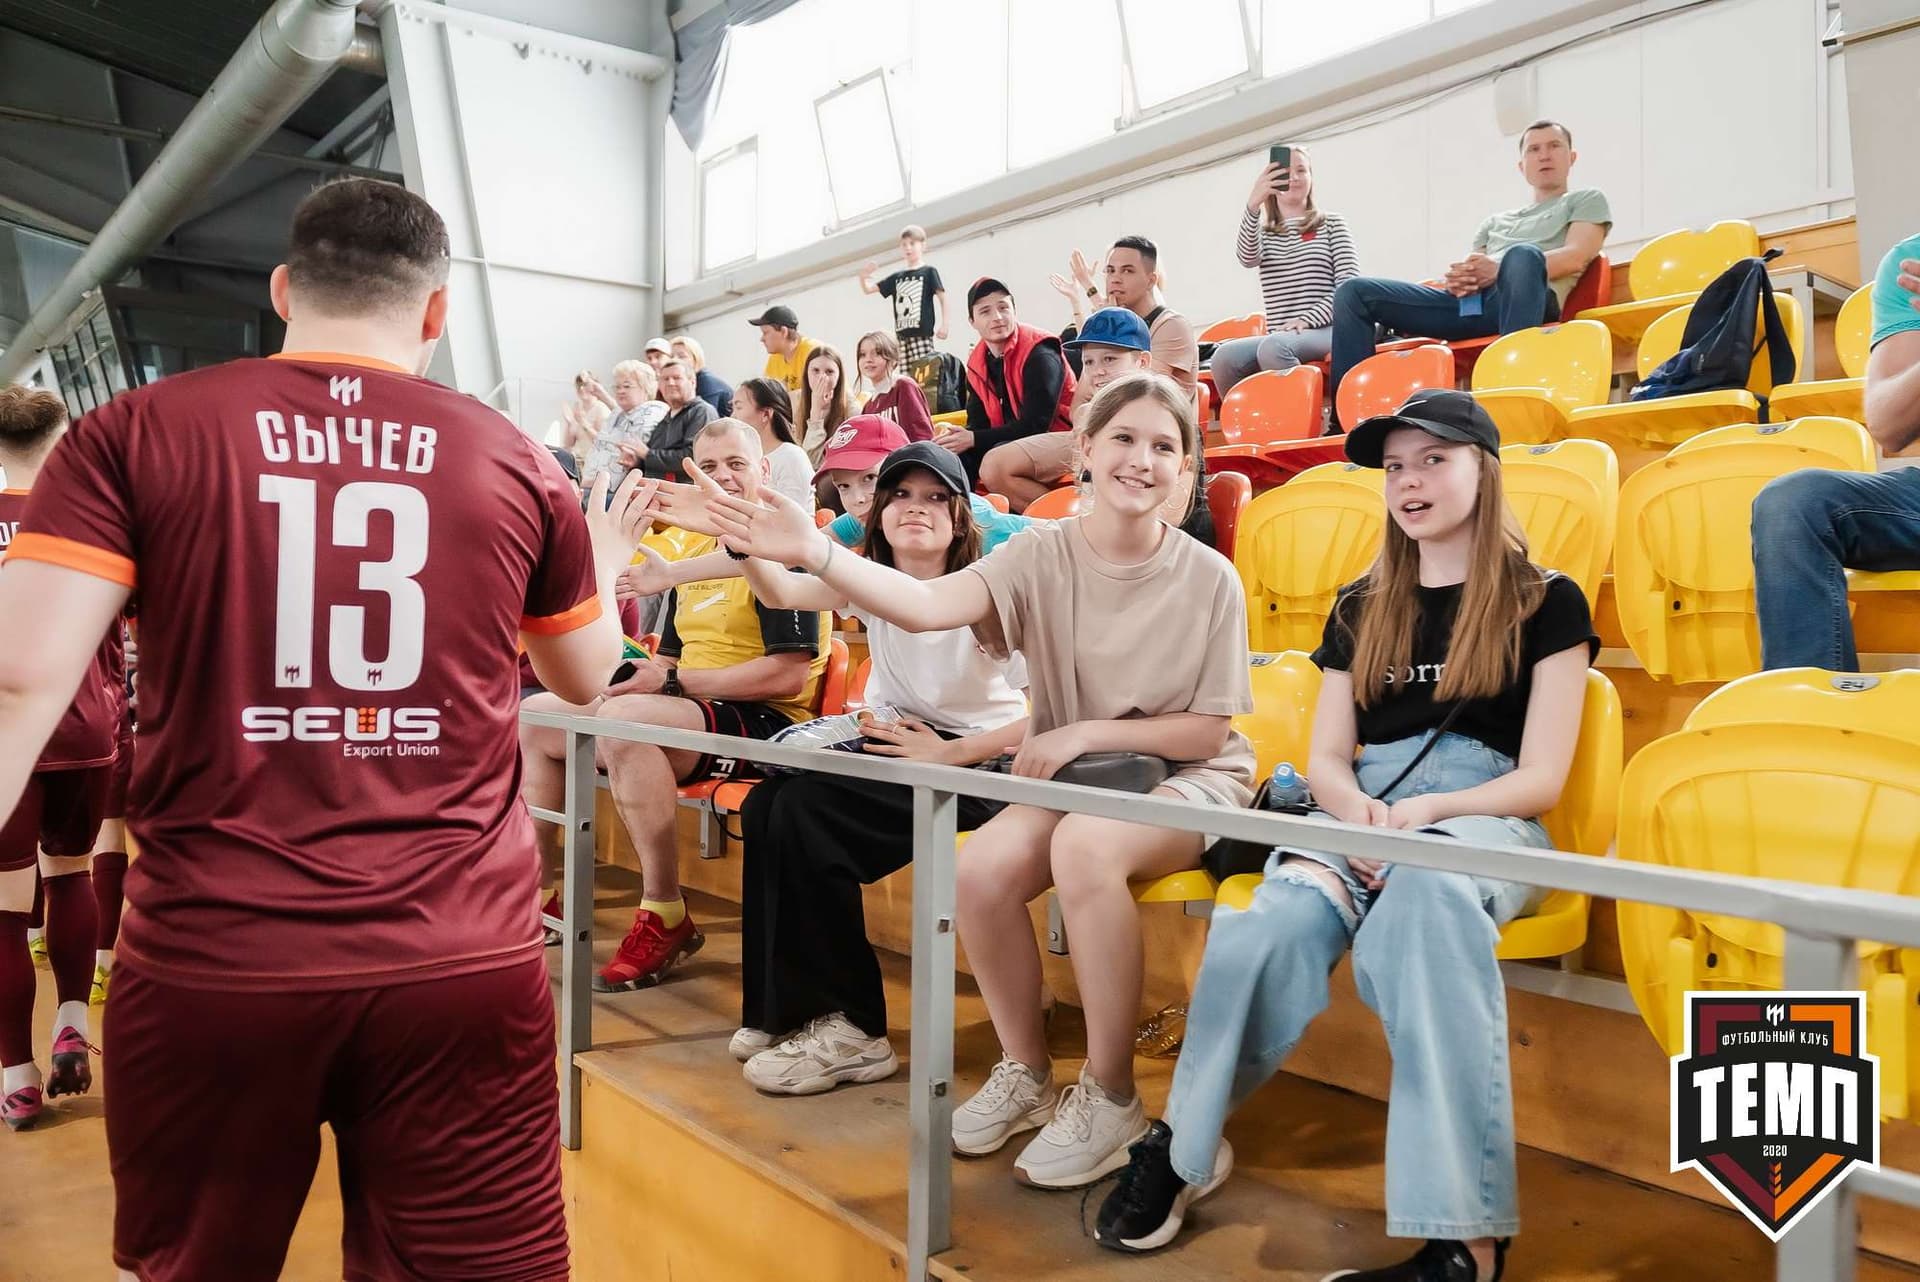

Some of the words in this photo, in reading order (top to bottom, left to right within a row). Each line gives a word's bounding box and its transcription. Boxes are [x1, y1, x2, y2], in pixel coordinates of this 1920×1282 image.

[255, 410, 438, 474] СЫЧЕВ
[258, 474, 430, 692] 13
[1383, 663, 1447, 684] sorr
[241, 706, 441, 742] SEUS
[343, 743, 393, 759] Export
[397, 743, 440, 756] Union
